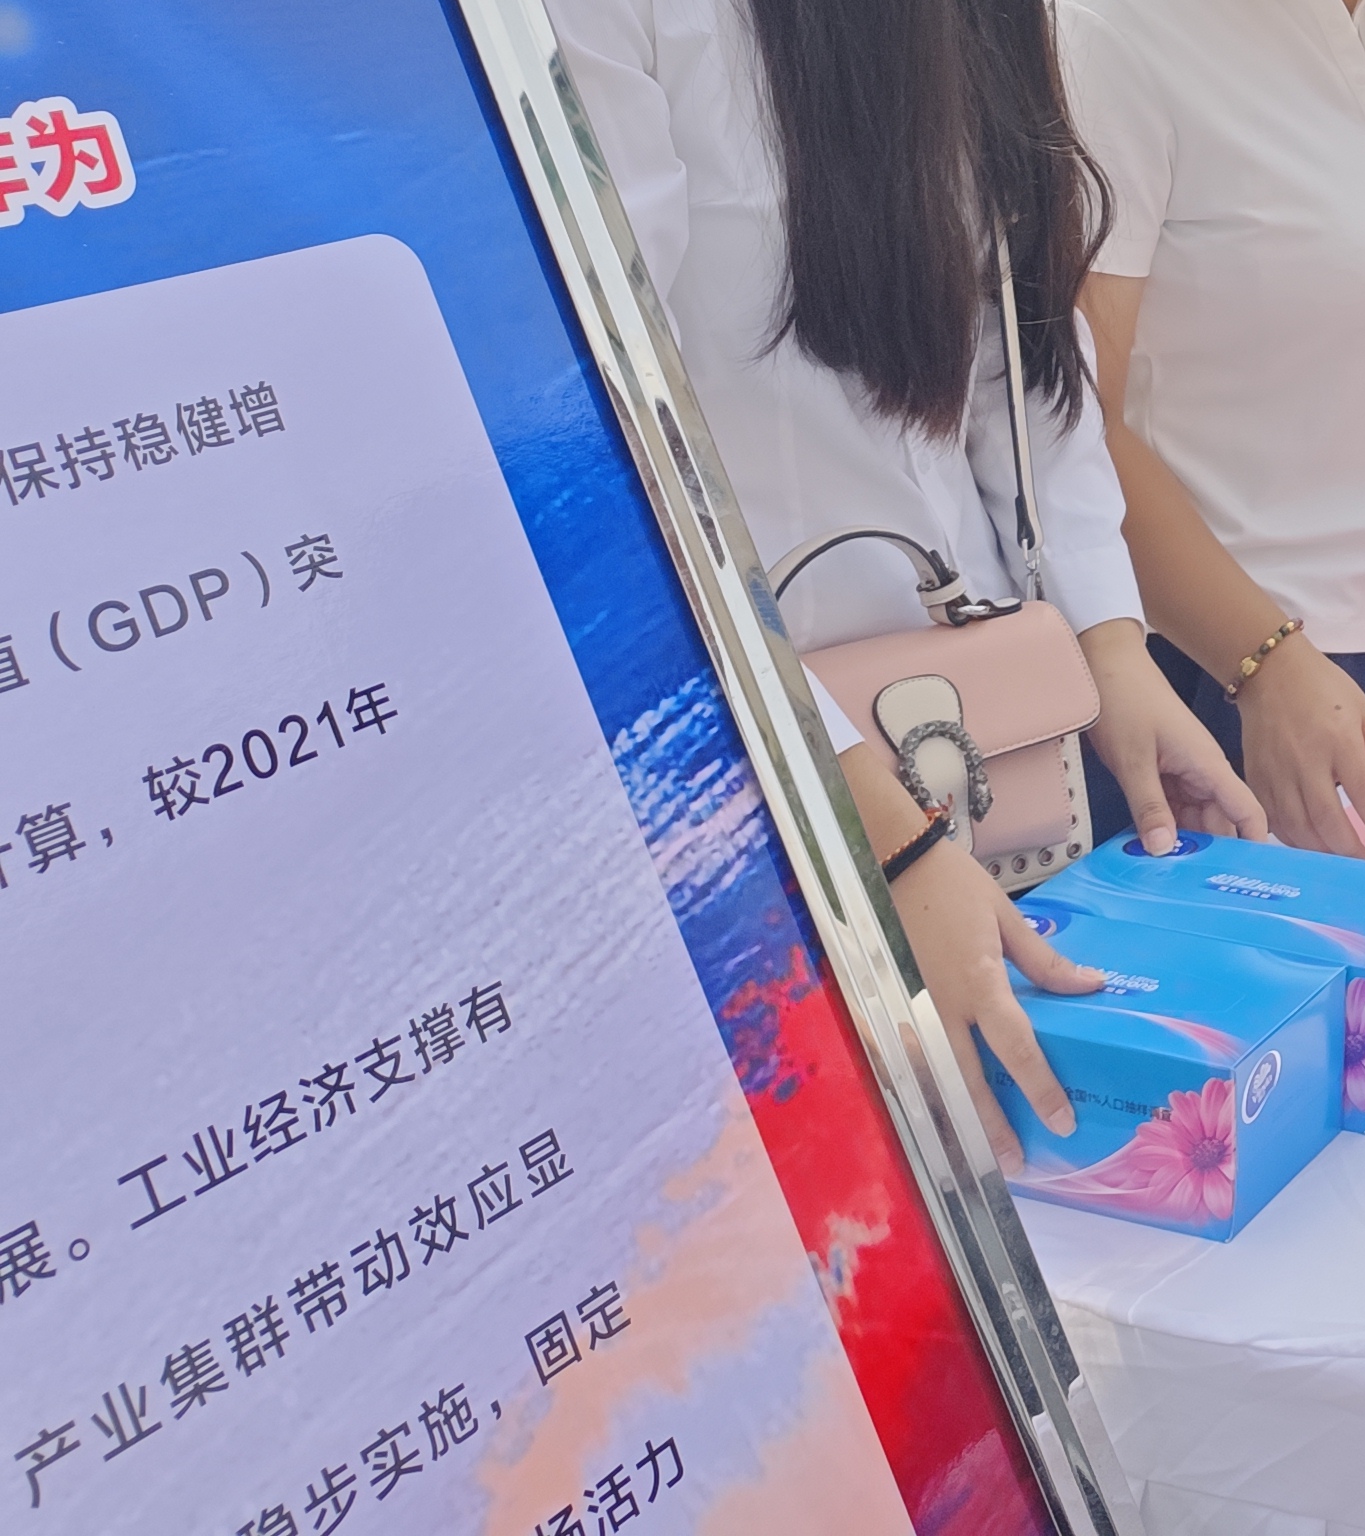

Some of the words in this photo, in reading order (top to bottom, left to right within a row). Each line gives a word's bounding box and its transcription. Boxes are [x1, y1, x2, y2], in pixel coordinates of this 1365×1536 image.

[0, 381, 286, 504] 保持稳健增
[14, 1127, 575, 1509] 产业集群带动效应显
